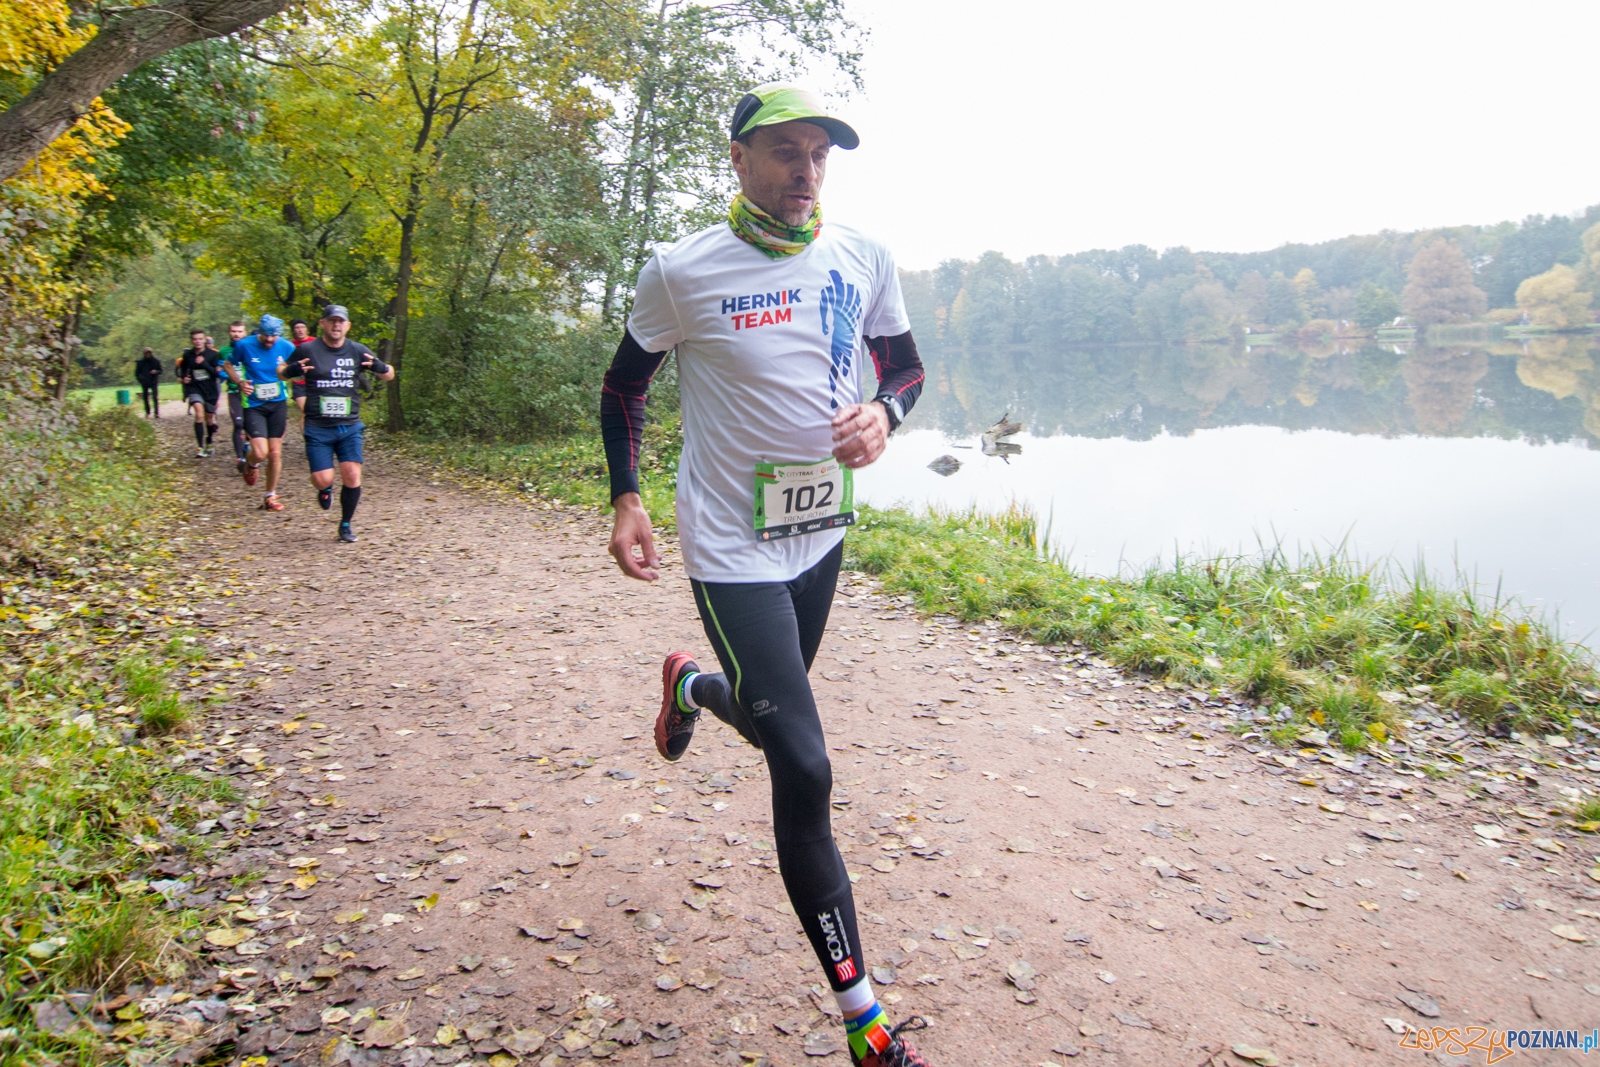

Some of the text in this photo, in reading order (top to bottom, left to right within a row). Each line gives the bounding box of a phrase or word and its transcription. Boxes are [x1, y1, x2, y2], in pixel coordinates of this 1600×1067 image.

[721, 288, 803, 315] HERNIK
[731, 307, 792, 331] TEAM
[335, 358, 355, 367] on
[330, 367, 355, 378] the
[316, 379, 354, 388] move
[326, 402, 345, 411] 536
[782, 480, 834, 514] 102
